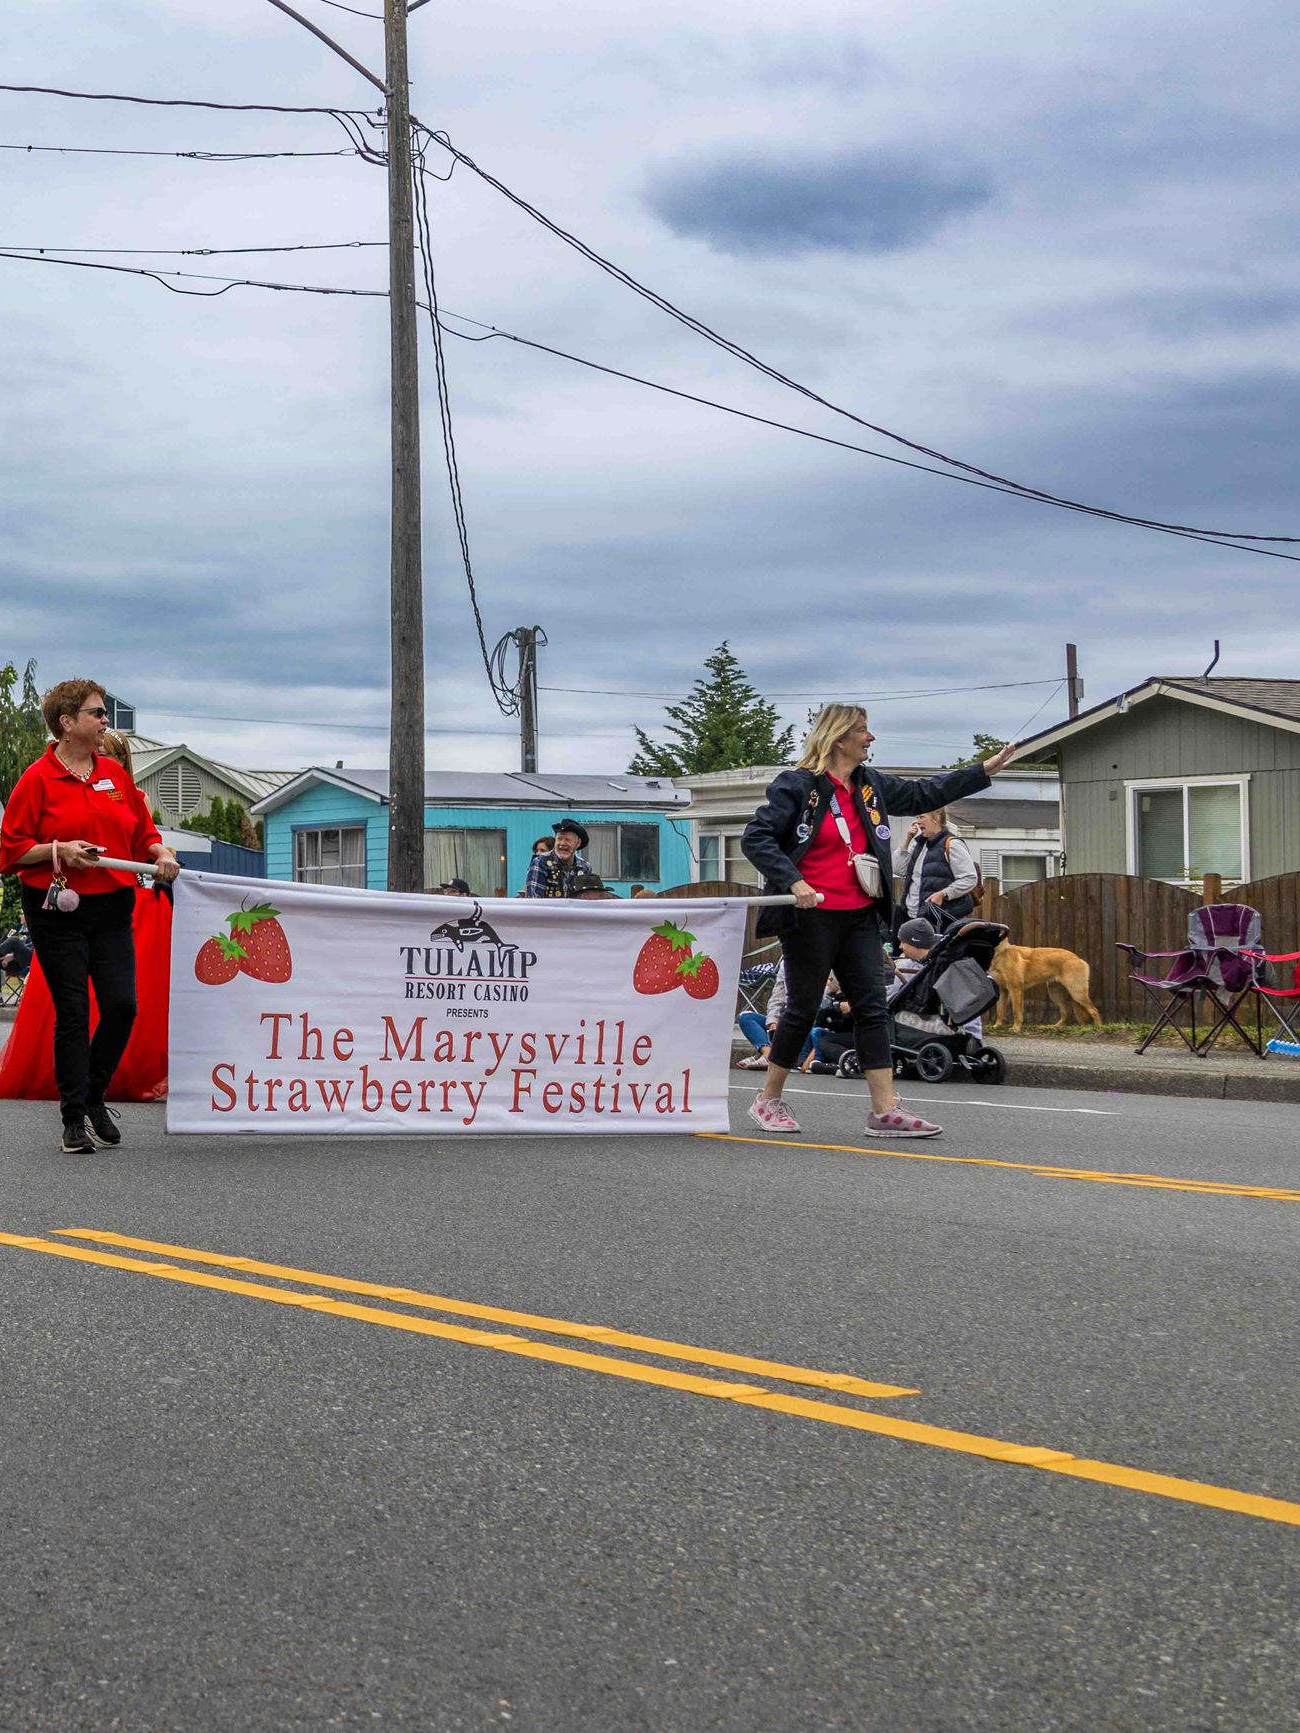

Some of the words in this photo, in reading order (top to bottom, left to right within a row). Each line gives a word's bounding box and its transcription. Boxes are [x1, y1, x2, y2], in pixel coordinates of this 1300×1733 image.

[400, 946, 538, 979] TULALIP
[404, 982, 466, 1000] RESORT
[473, 984, 529, 1002] CASINO
[446, 1008, 489, 1018] PRESENTS
[260, 1013, 354, 1062] The
[380, 1015, 652, 1076] Marysville
[211, 1063, 486, 1125] Strawberry
[508, 1068, 692, 1113] Festival
